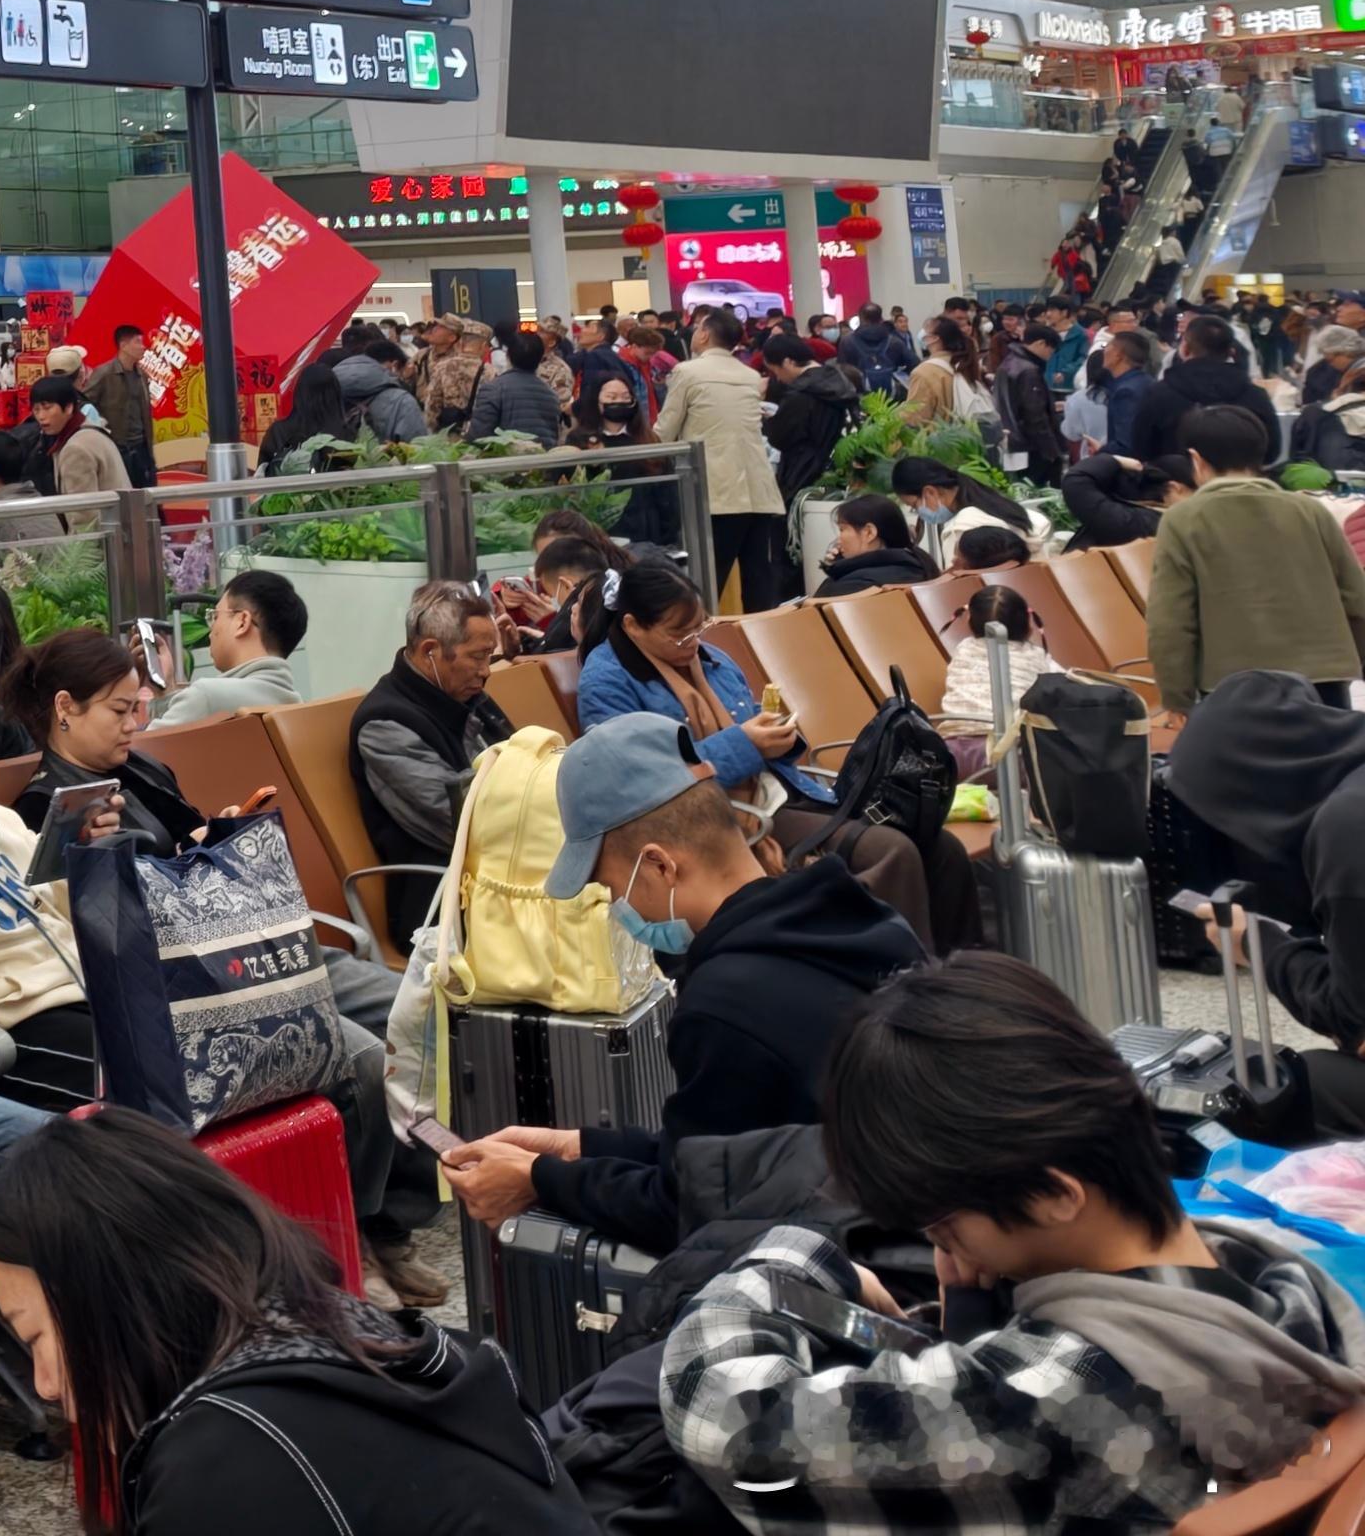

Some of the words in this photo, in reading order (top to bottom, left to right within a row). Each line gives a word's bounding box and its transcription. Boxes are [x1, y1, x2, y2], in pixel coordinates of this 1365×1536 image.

[1039, 10, 1111, 46] McDonald's
[1242, 5, 1323, 35] 牛肉面
[244, 57, 283, 78] Nursing
[284, 60, 312, 77] Room
[262, 26, 310, 55] 哺乳室
[352, 53, 379, 81] (东)
[377, 34, 405, 62] 出口
[387, 66, 407, 83] Exit
[371, 175, 486, 204] 爱心家园
[449, 275, 471, 314] 1B
